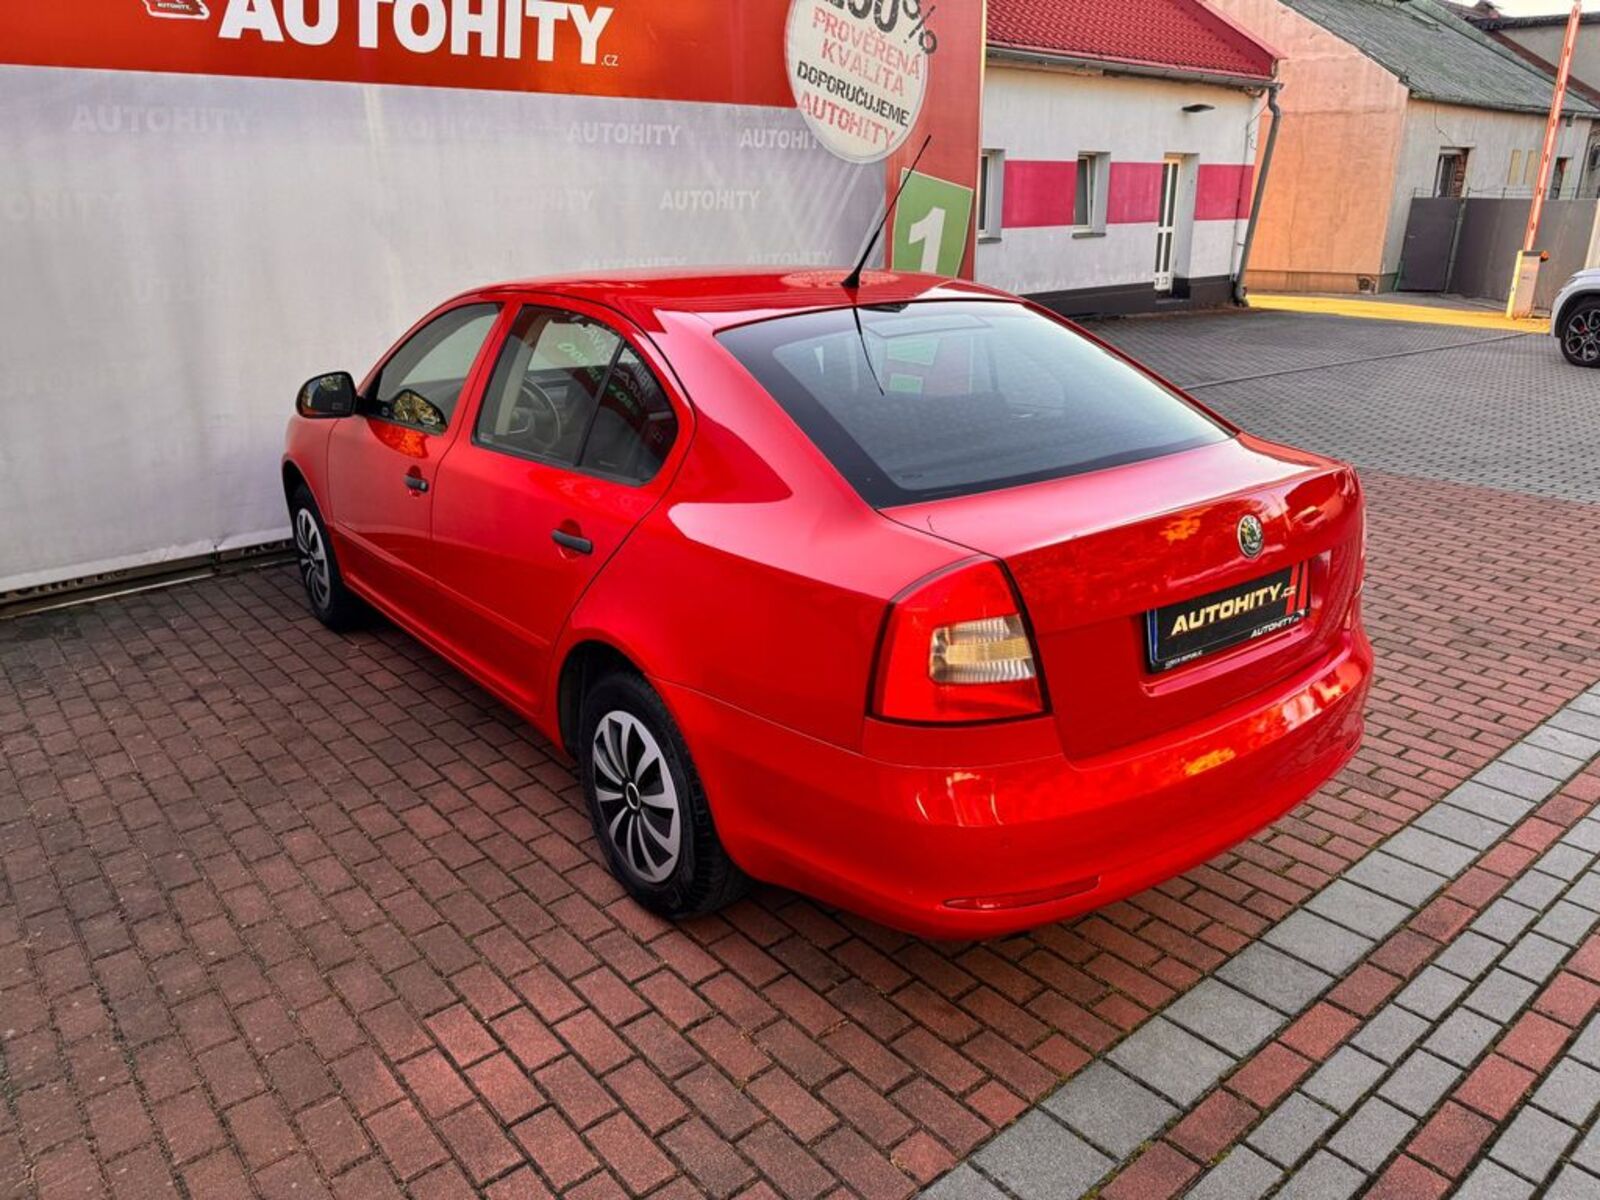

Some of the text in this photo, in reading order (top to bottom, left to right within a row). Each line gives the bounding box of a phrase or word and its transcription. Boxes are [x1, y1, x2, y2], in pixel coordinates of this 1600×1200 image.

[812, 6, 921, 80] PROVĚŘENÁ
[820, 38, 905, 97] KVALITA
[797, 60, 910, 128] DOPORUČUJEME
[800, 90, 895, 149] AUTOHITY
[566, 121, 681, 146] AUTOHITY
[739, 128, 818, 149] AUTOHI
[659, 188, 761, 211] AUTOHITY
[908, 206, 946, 274] 1
